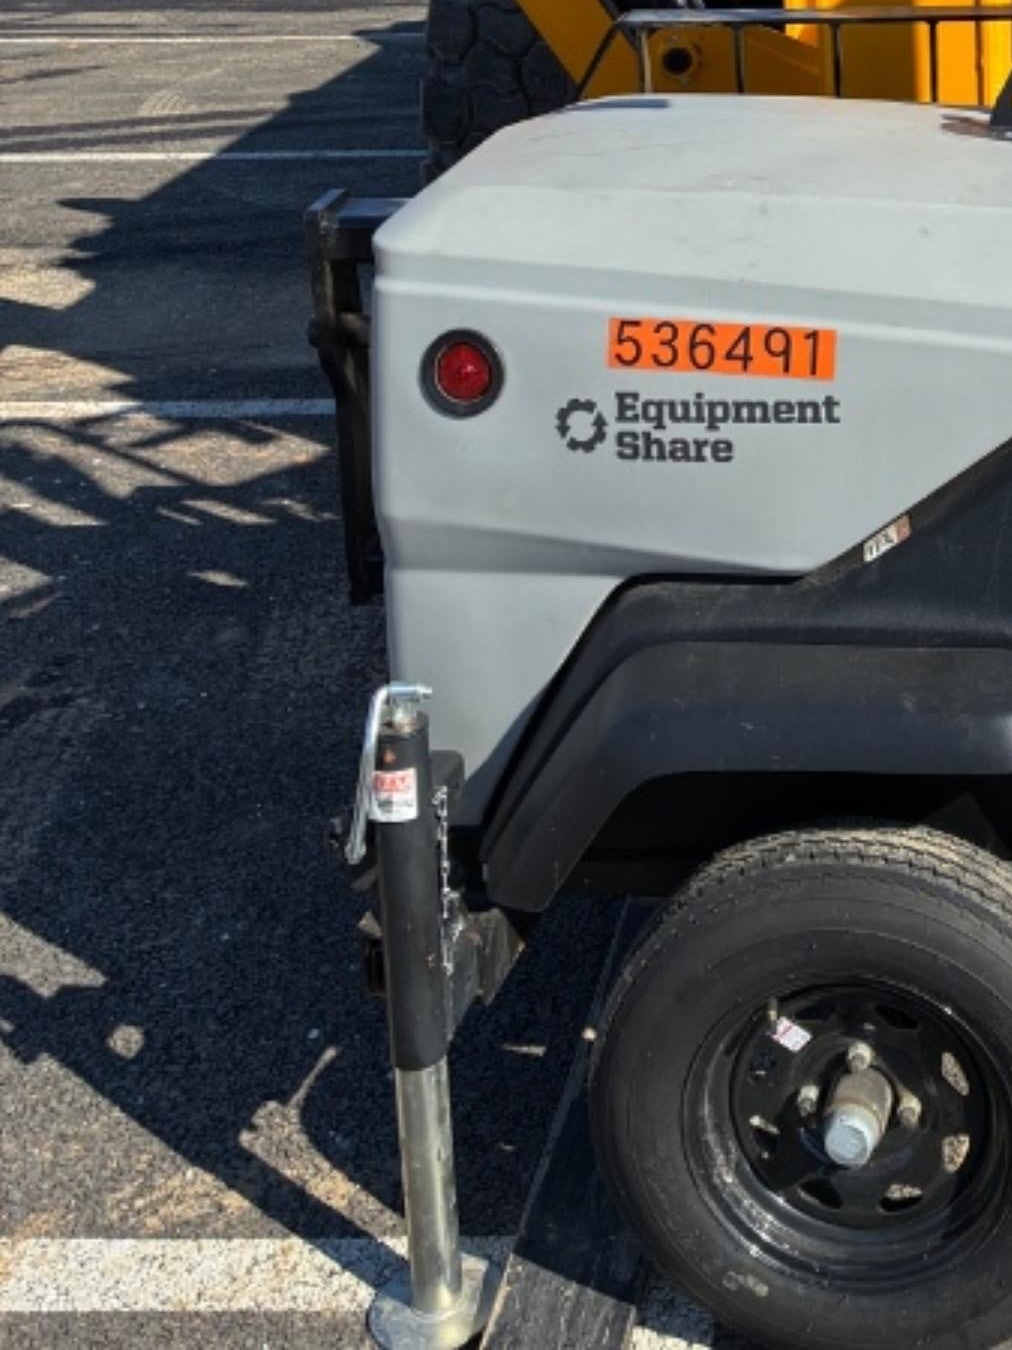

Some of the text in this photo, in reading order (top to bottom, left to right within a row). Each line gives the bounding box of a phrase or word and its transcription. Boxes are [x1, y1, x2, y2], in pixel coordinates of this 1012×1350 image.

[614, 320, 821, 377] 536491
[614, 392, 841, 432] Equipment
[615, 431, 735, 463] Share
